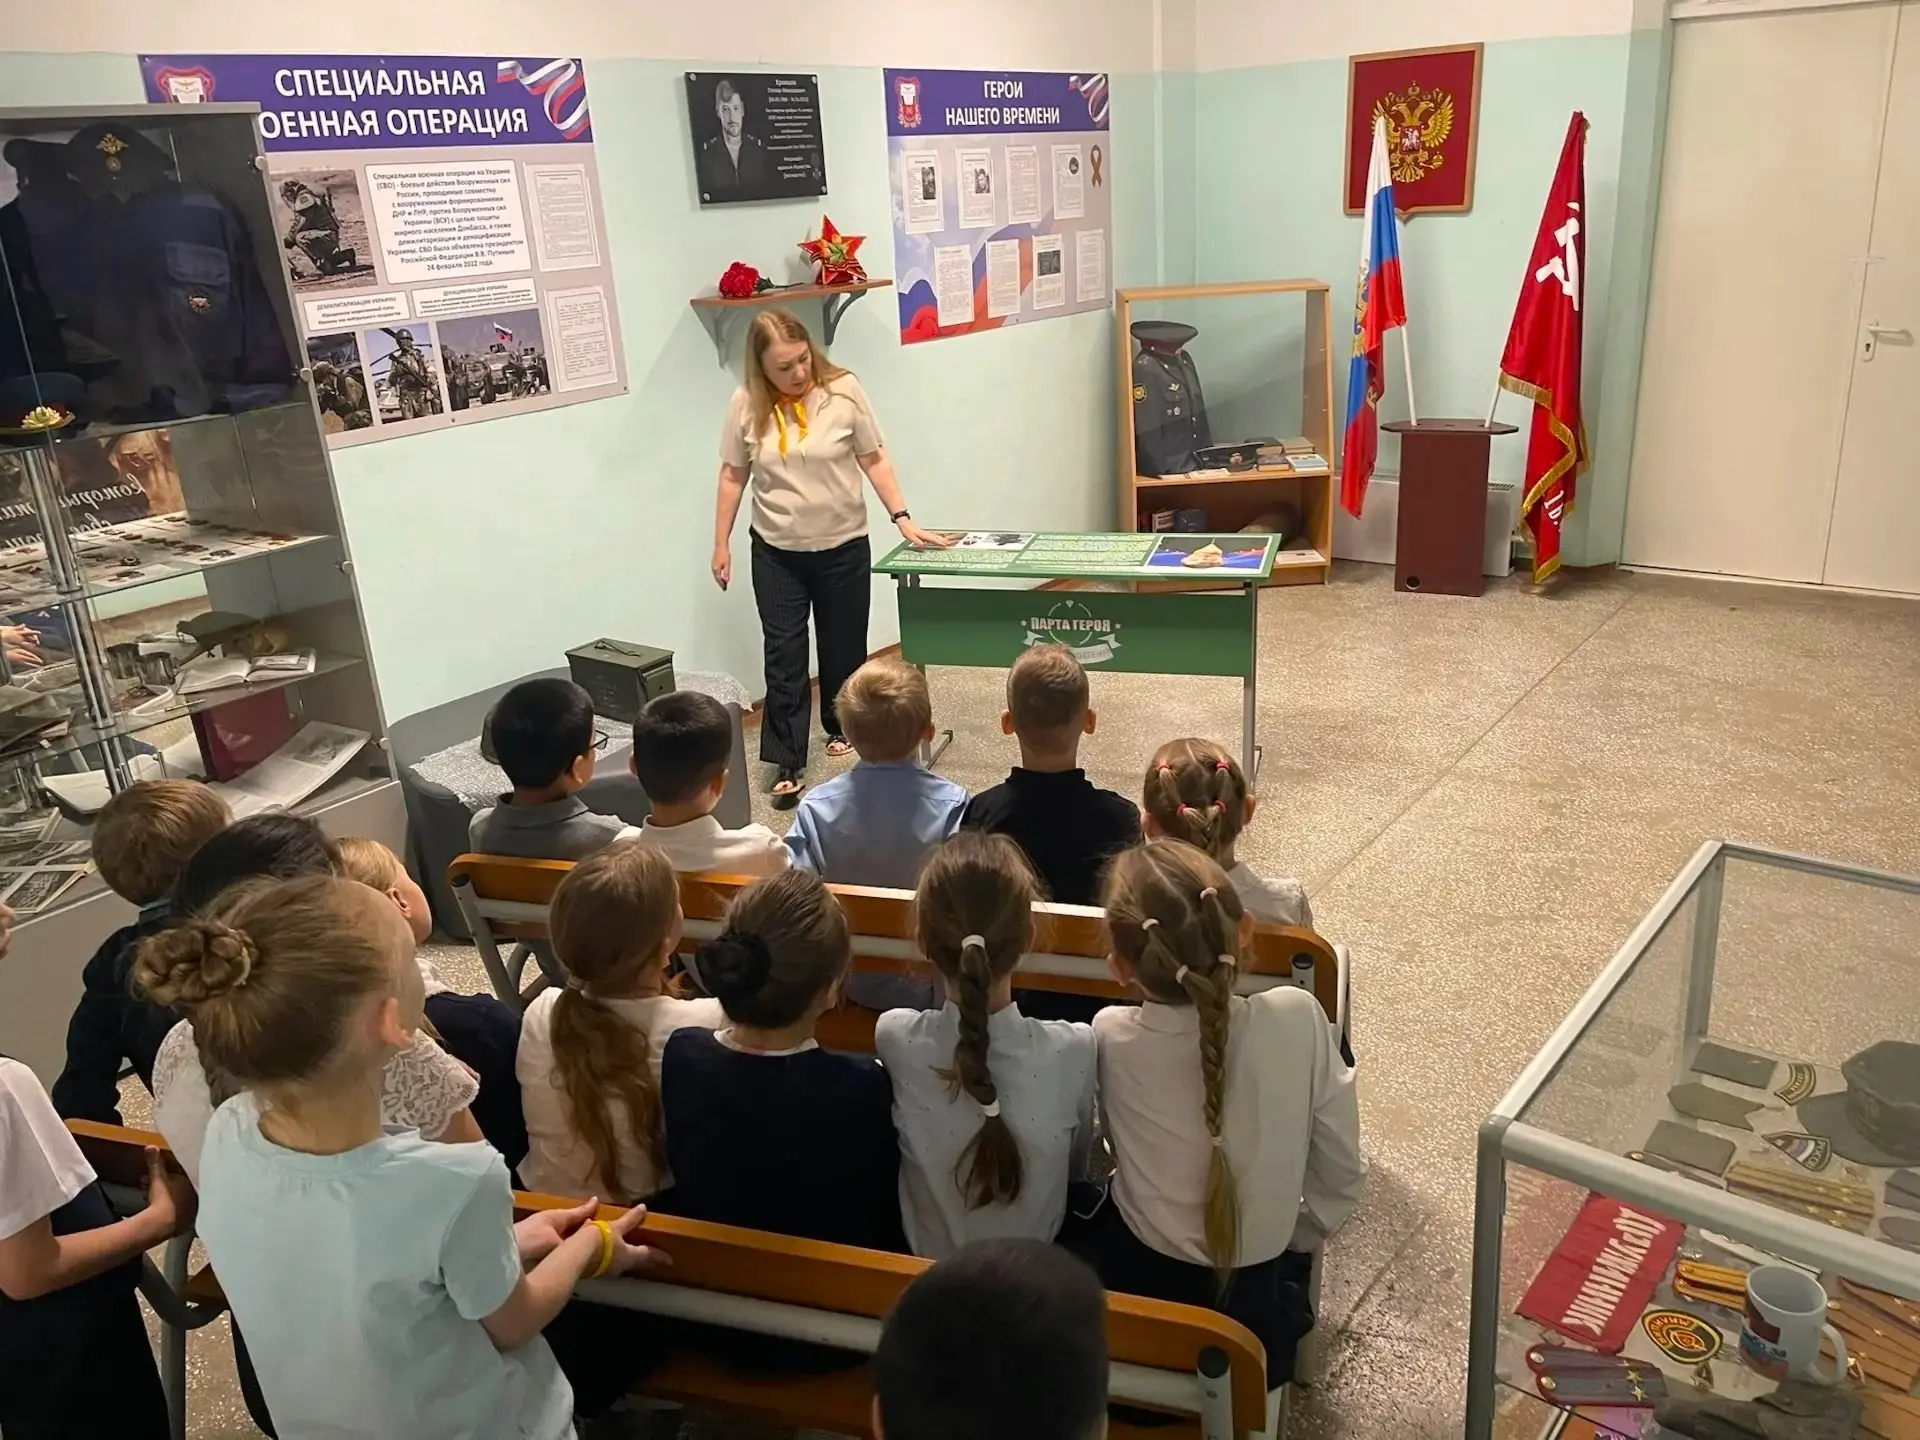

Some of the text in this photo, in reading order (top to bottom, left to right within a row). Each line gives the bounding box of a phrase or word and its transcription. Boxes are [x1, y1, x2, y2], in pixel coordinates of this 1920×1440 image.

[275, 69, 486, 101] СПЕЦИАЛЬНАЯ
[984, 81, 1023, 98] ГЕРОИ
[946, 107, 1060, 126] НАШЕГО ВРЕМЕНИ
[258, 108, 528, 139] ОЕННАЯ ОПЕРАЦИЯ
[373, 172, 416, 180] Специальная
[377, 182, 395, 190] (СВО)
[423, 189, 463, 197] проводимые
[449, 196, 503, 205] формированиями
[433, 217, 450, 225] (ВСУ)
[458, 224, 488, 232] Донбасса,
[485, 240, 523, 248] президентом
[401, 255, 437, 263] Российской
[439, 253, 473, 261] Федерации
[488, 249, 515, 257] Путиным
[436, 262, 462, 270] февраля
[1031, 617, 1110, 632] ПАРТА ГЕРОЯ
